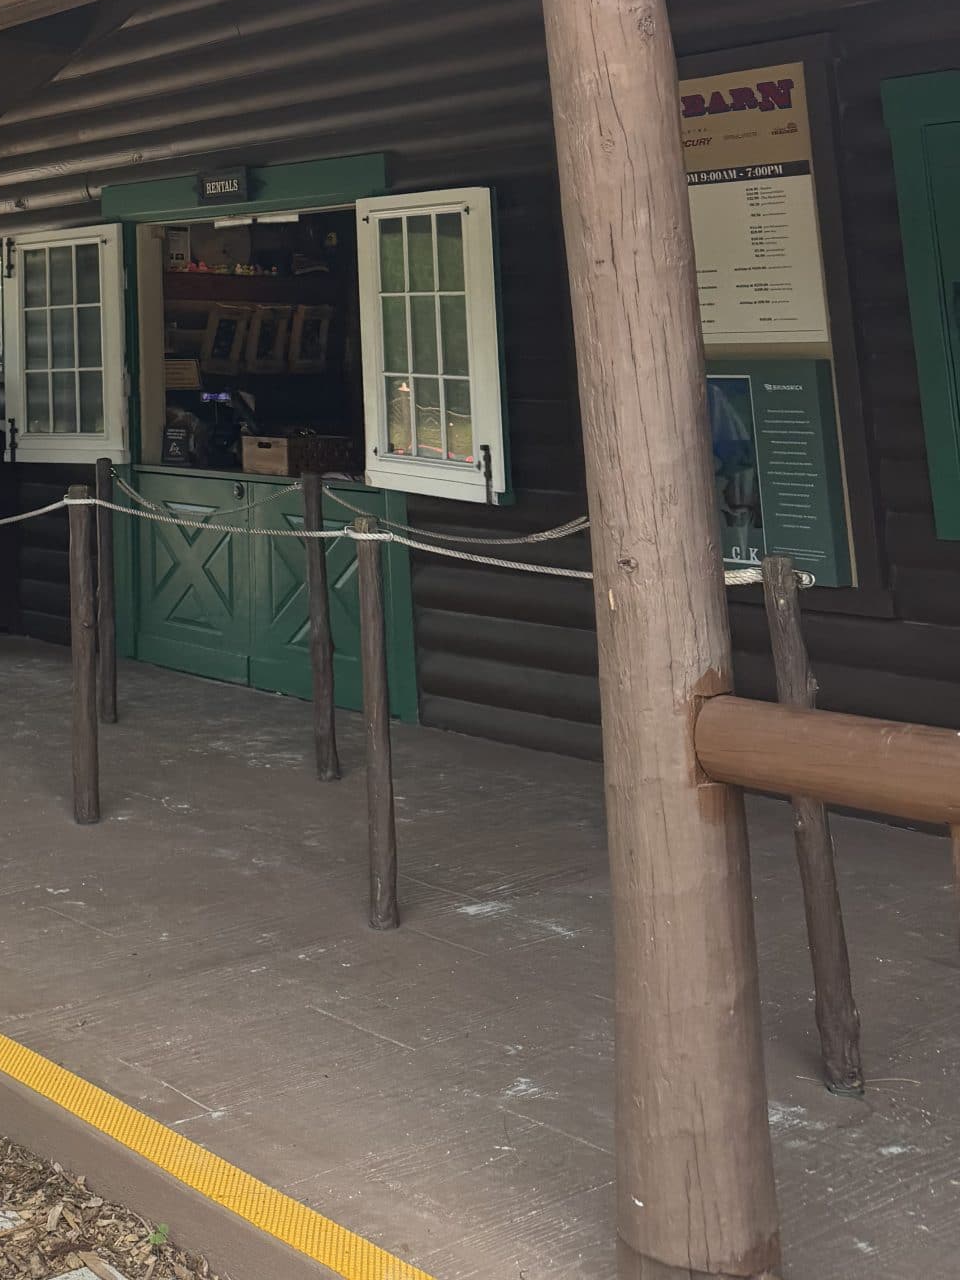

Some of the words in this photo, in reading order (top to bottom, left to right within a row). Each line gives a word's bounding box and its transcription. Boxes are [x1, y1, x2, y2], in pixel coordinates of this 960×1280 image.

[681, 79, 794, 118] BARN
[682, 137, 712, 148] CURY
[700, 169, 737, 182] 9:00AM
[745, 164, 783, 178] 7:00PM
[206, 179, 238, 194] RENTALS
